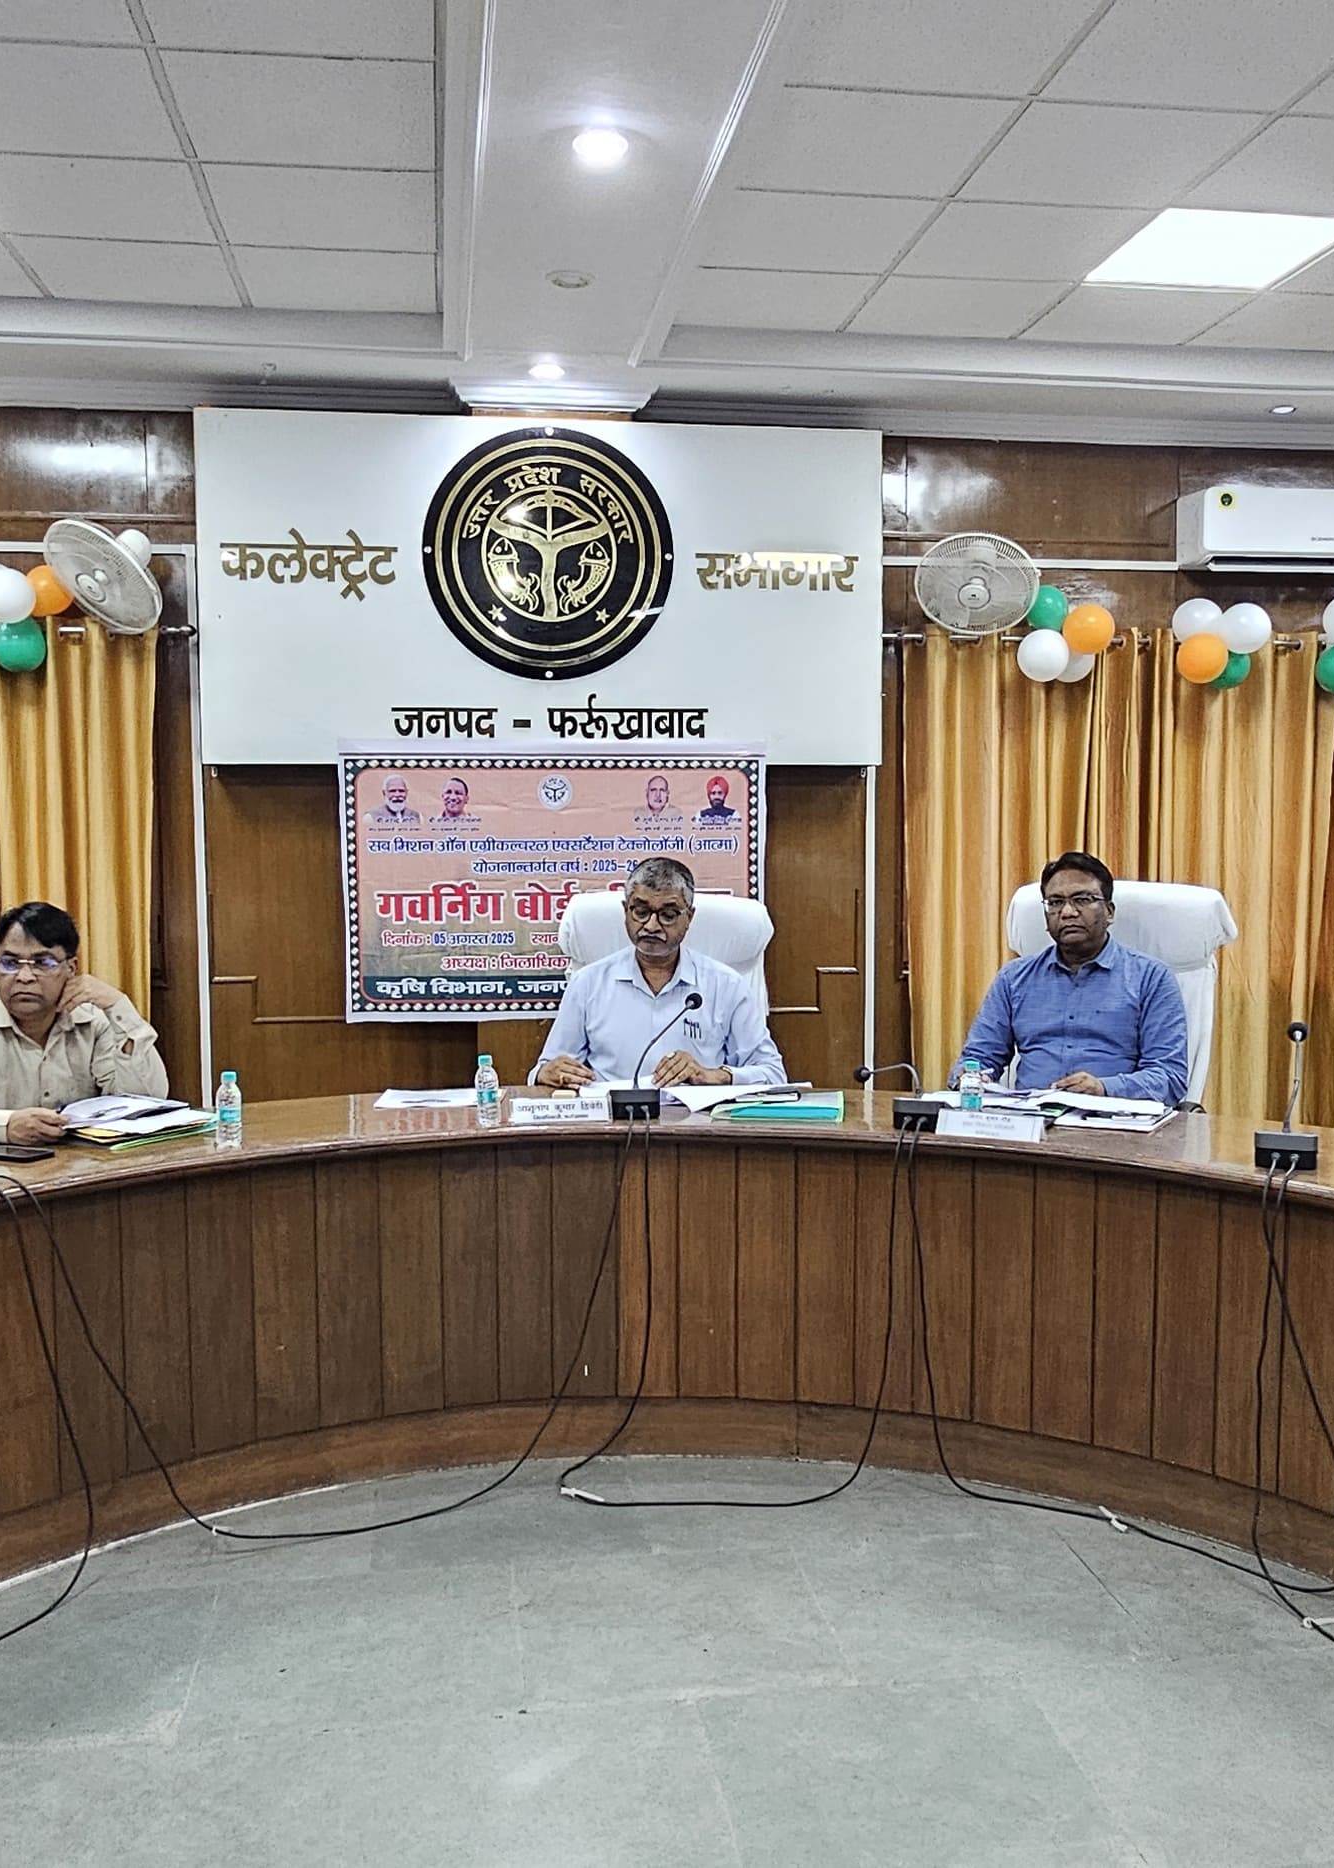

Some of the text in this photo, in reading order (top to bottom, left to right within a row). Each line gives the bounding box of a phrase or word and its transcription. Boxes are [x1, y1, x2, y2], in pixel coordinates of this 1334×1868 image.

[462, 465, 634, 544] उत्तर प्रदेश सरकार
[220, 527, 398, 602] कलेक्ट्रेट
[391, 706, 498, 739] जनपद
[368, 839, 390, 852] सब
[394, 837, 433, 852] मिशन
[437, 836, 466, 852] ऑन
[470, 836, 548, 853] एग्रीकल्चरल
[618, 835, 684, 852] टेक्नोलॉजी
[688, 834, 738, 854] (आत्मा)
[473, 858, 557, 873] योजनान्तर्गत
[560, 858, 580, 873] वर्ष
[382, 931, 423, 945] दिनांक
[434, 933, 445, 944] 05
[449, 932, 488, 945] अगस्त
[491, 932, 514, 944] 2025
[442, 956, 487, 970] अध्यक्ष
[500, 953, 571, 970] जिलाधिका
[376, 977, 567, 998] कृषि विभाग, जनप
